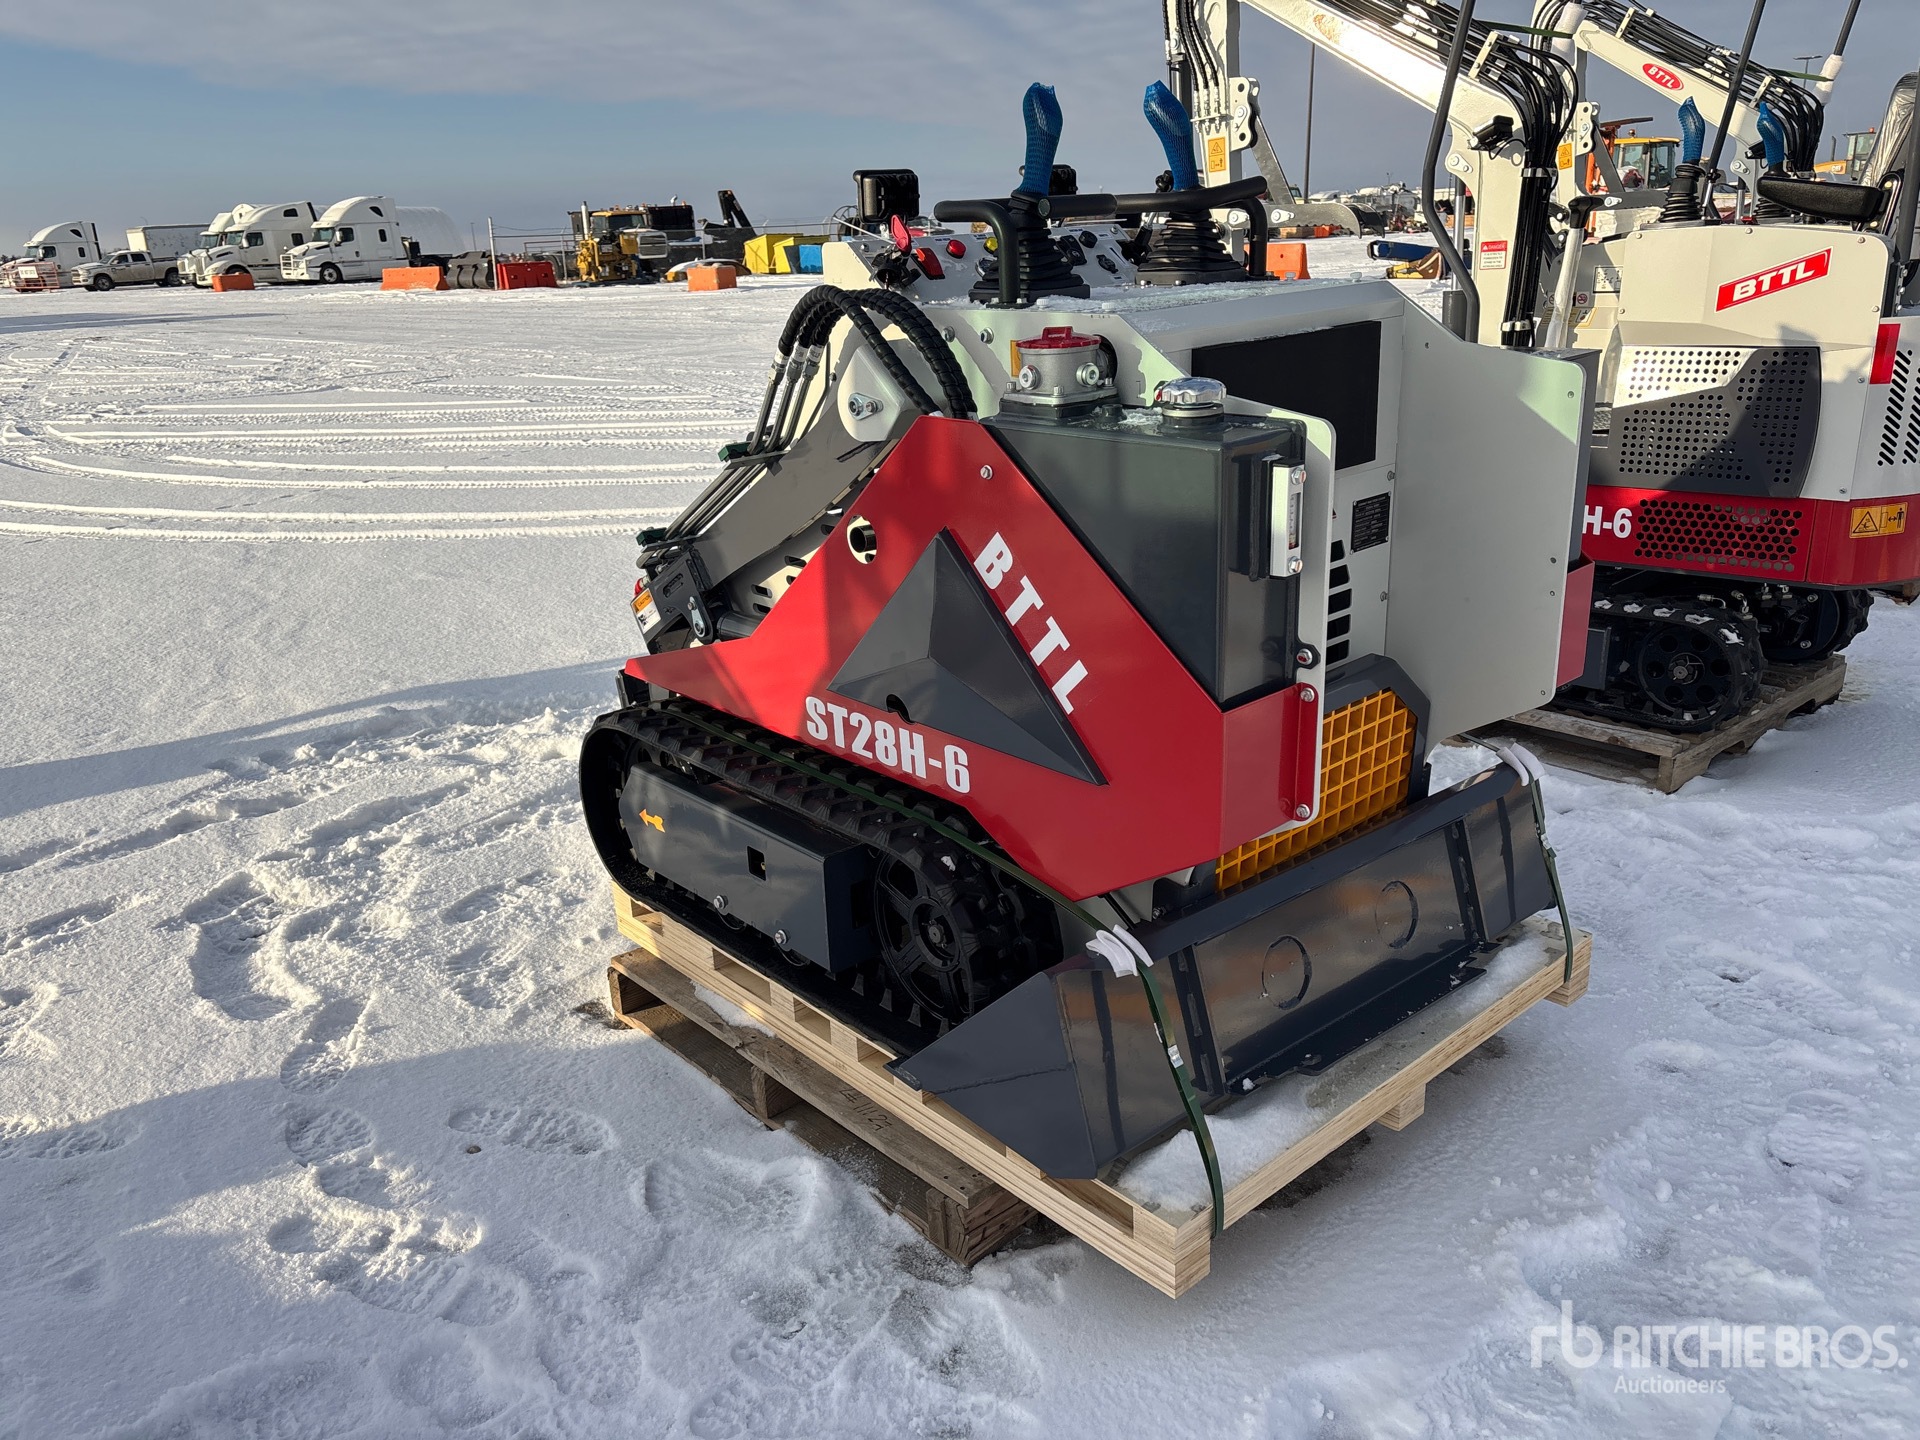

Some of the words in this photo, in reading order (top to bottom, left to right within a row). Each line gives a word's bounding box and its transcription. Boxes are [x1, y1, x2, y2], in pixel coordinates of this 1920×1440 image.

[1648, 66, 1675, 88] BTTL
[1732, 261, 1815, 302] BTTL
[973, 531, 1089, 716] BTTL
[805, 696, 971, 794] ST28H-6
